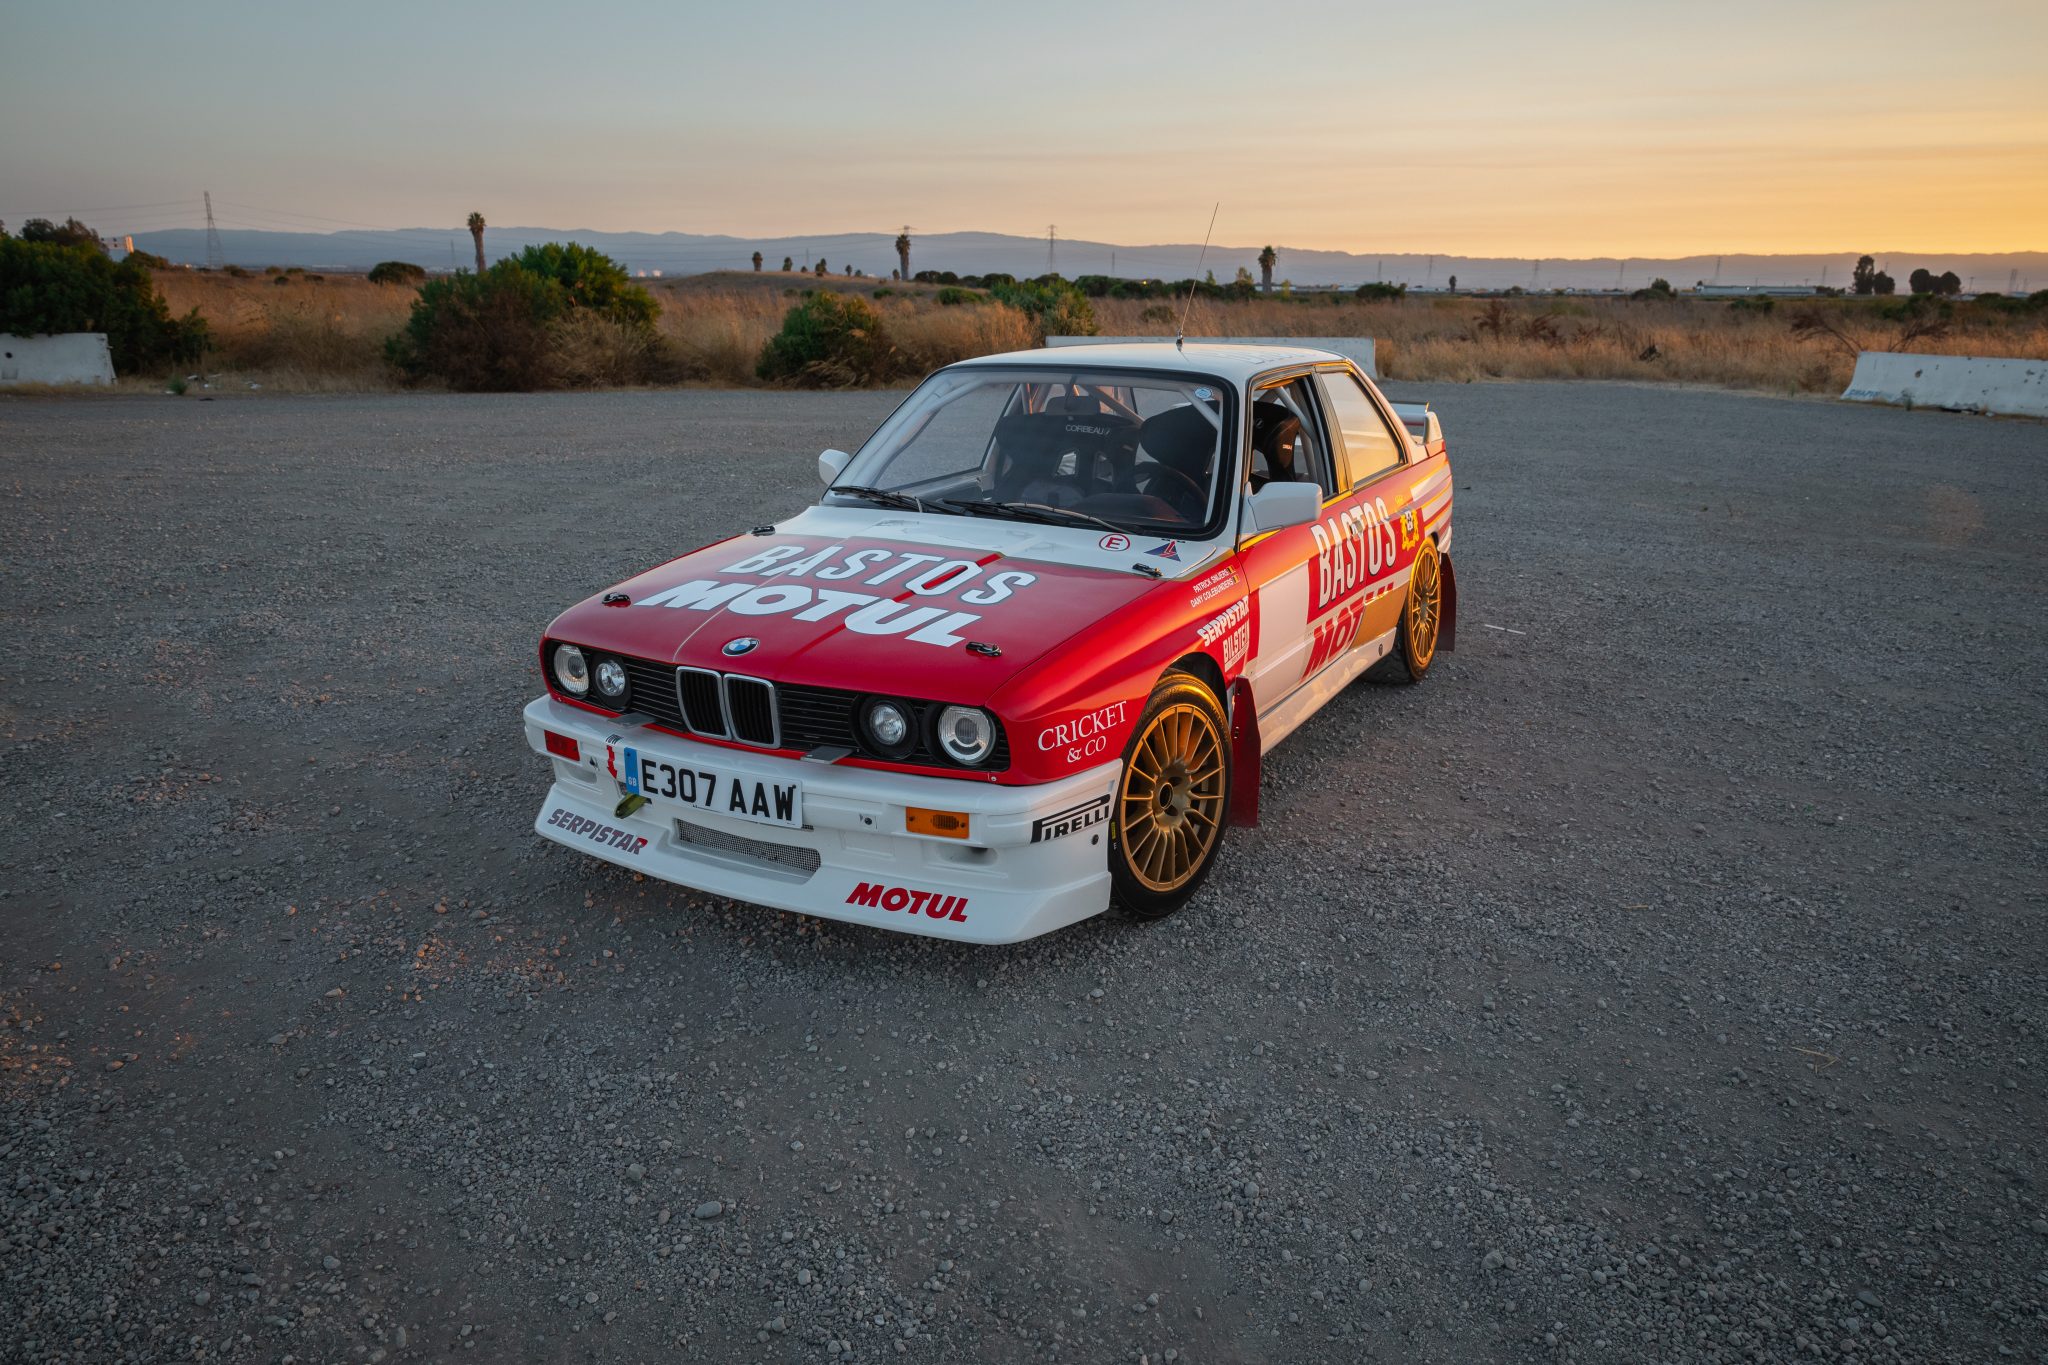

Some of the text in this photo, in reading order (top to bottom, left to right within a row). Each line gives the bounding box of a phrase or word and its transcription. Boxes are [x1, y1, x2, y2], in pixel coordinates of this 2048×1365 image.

[1065, 424, 1104, 435] CORBEAU
[1106, 537, 1123, 549] E
[1309, 496, 1396, 609] BASTOS
[718, 545, 1037, 604] BASTOS
[634, 580, 982, 648] MOTUL
[1196, 594, 1249, 647] SERPISTAR
[1037, 700, 1127, 751] CRICKET
[1067, 735, 1107, 763] & CO
[641, 758, 795, 821] E307 AAW
[547, 808, 648, 855] SERPISTAR
[1030, 793, 1111, 844] PIRELLI
[845, 882, 968, 922] MOTUL
